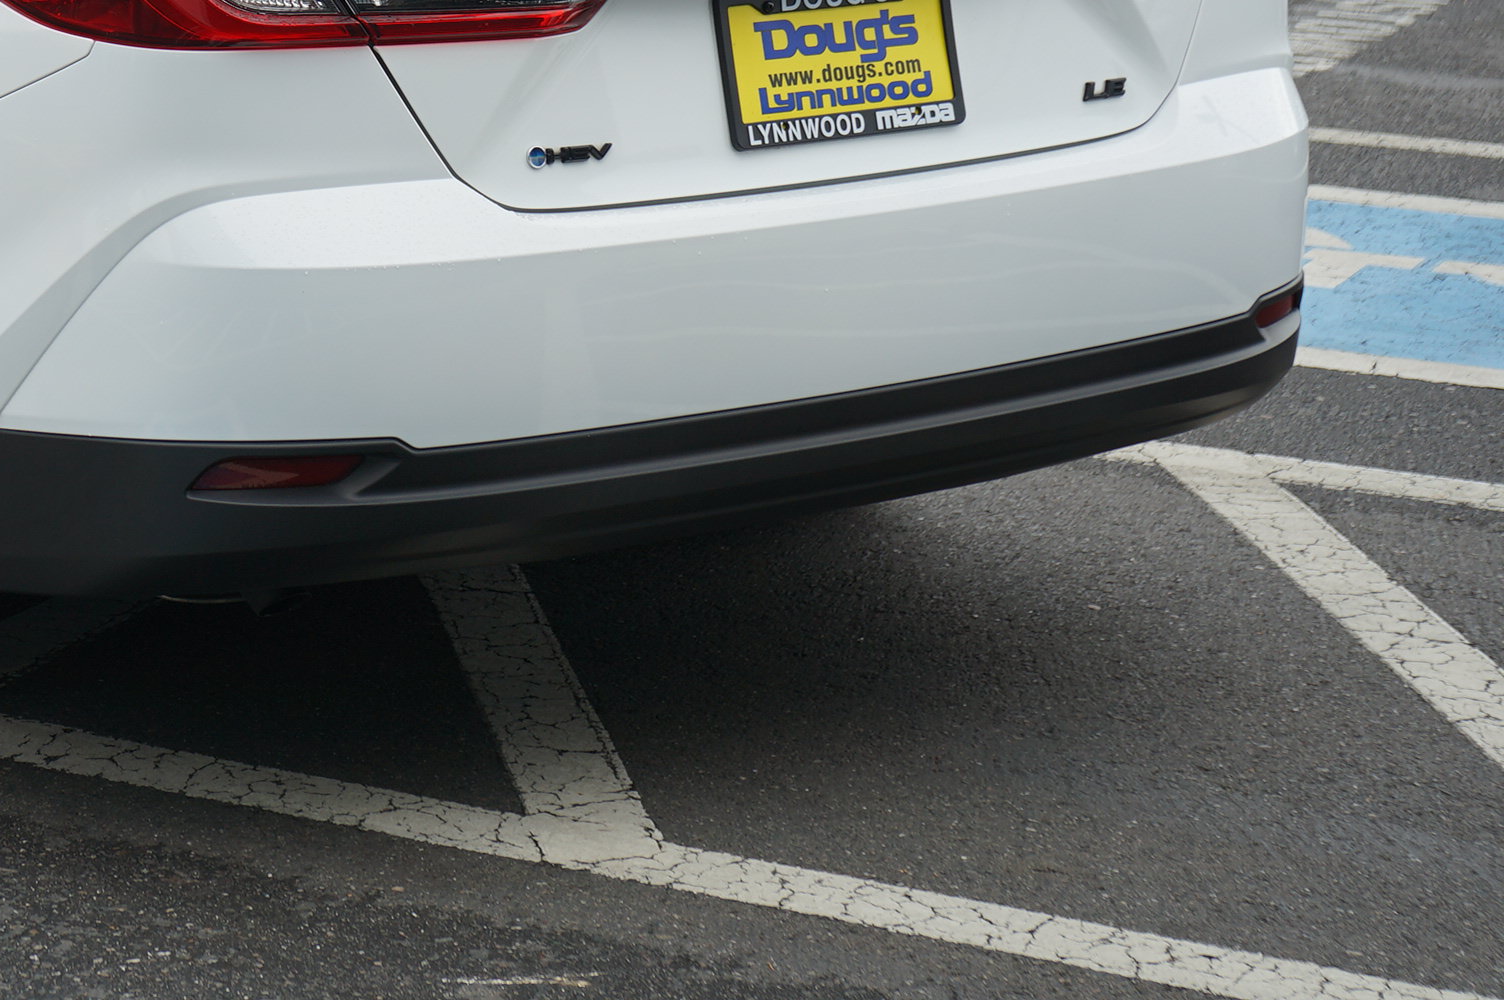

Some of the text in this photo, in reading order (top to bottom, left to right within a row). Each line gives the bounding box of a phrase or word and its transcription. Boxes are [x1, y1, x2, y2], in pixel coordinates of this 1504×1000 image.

[753, 9, 919, 63] Doug's
[768, 58, 922, 87] www.dougs.com
[758, 70, 933, 115] Lynnwood
[1082, 77, 1127, 102] LE
[747, 112, 866, 146] LYNNWOOD
[545, 143, 613, 165] HEV
